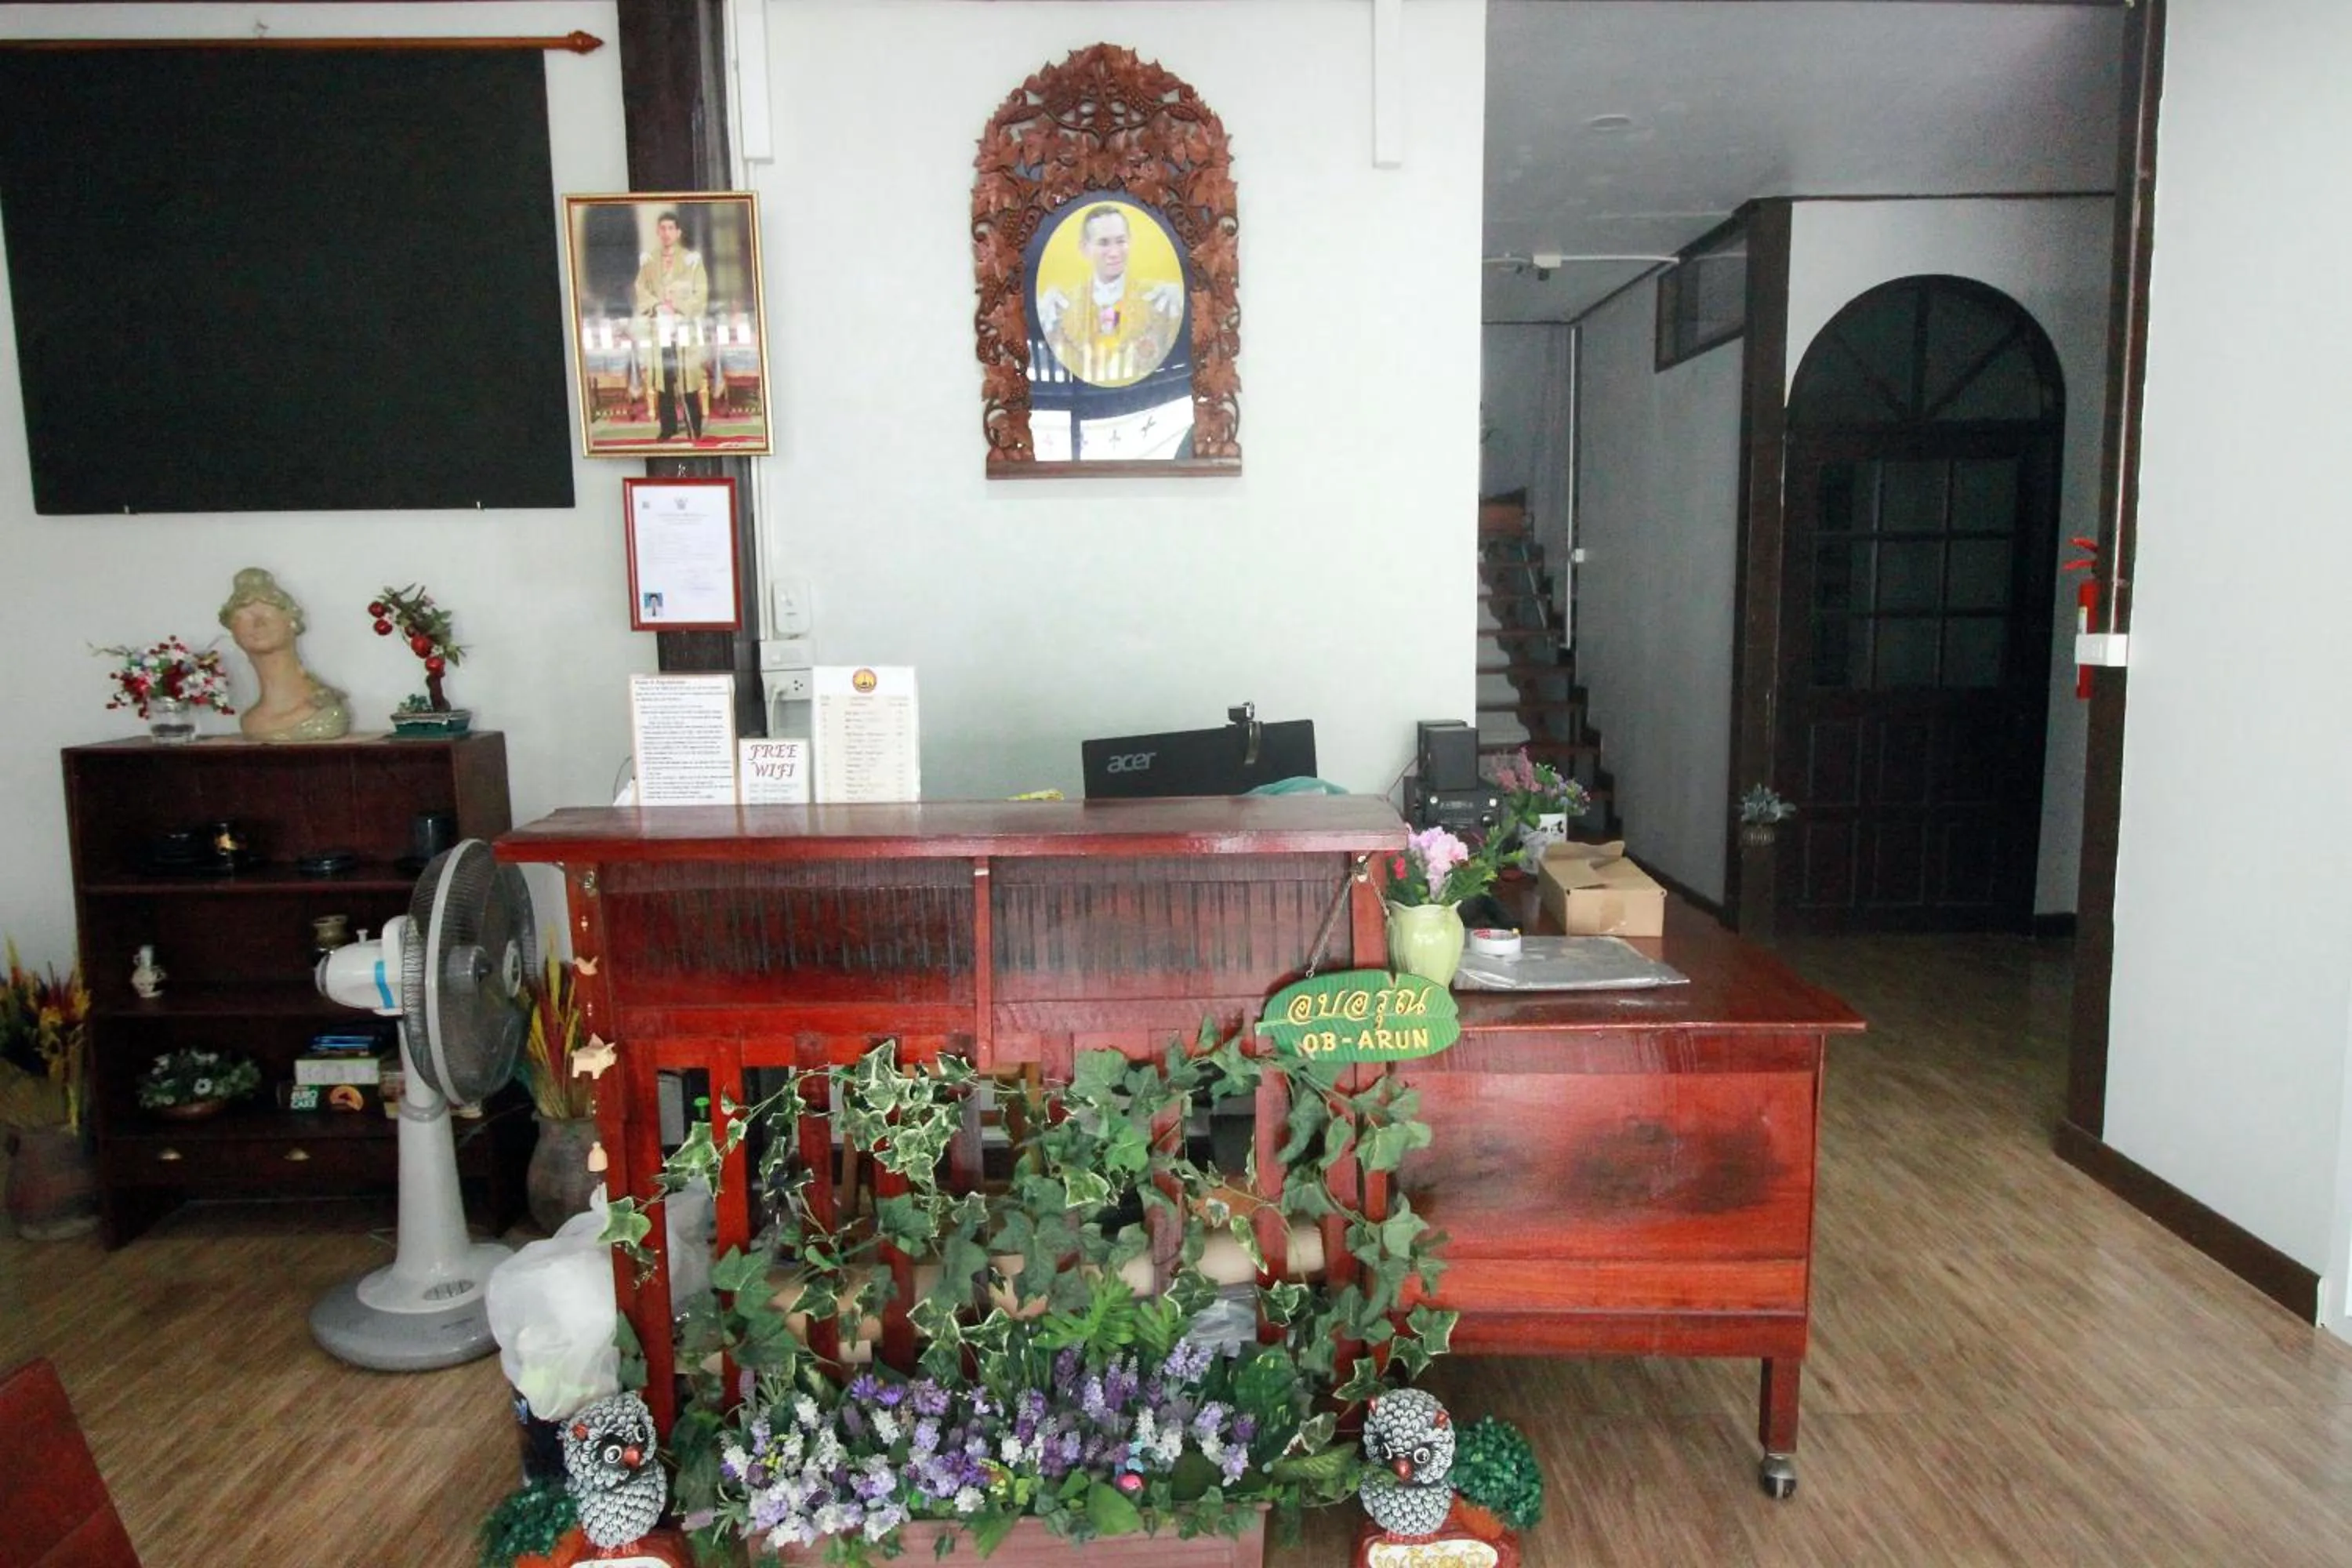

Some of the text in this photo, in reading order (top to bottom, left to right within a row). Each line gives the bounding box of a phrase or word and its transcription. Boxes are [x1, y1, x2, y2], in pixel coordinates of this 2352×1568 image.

[747, 744, 798, 761] FREE
[1106, 751, 1157, 774] acer
[751, 762, 795, 780] WIFI
[1302, 1029, 1428, 1053] OB-ARUN
